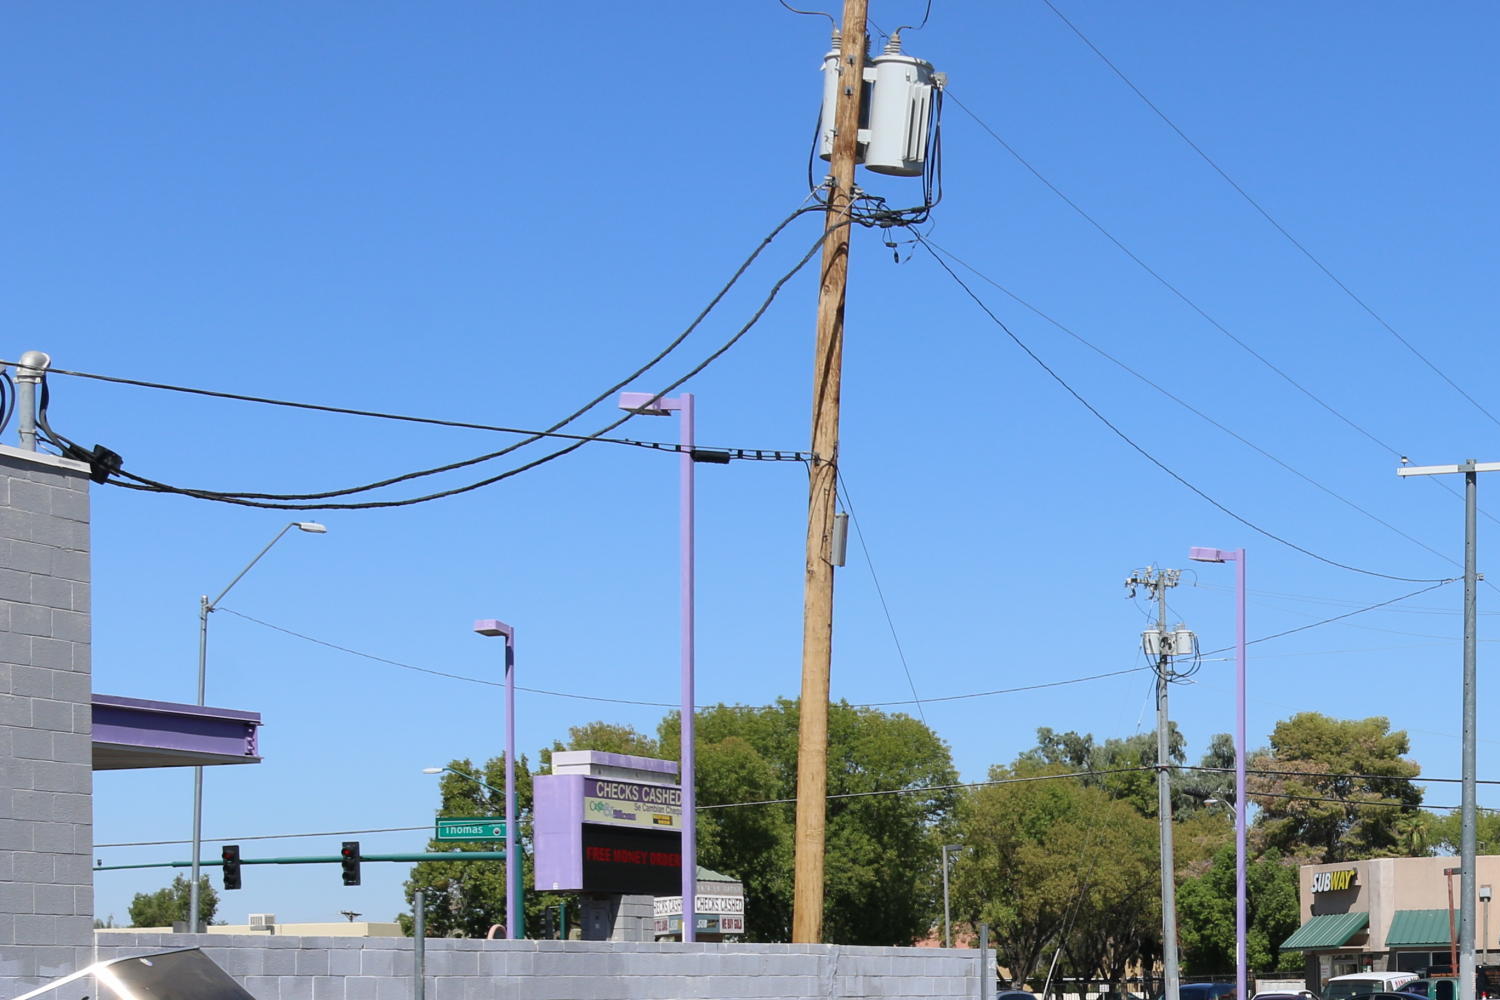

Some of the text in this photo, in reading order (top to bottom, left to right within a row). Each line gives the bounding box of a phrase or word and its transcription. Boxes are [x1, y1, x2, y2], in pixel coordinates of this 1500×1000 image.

[597, 781, 682, 806] CHECKS CASHED
[446, 825, 483, 834] Thomas
[586, 847, 611, 862] FREE
[613, 849, 648, 865] MONEY
[1311, 870, 1355, 893] SUBWAY
[696, 896, 743, 912] CHECKS CASHED
